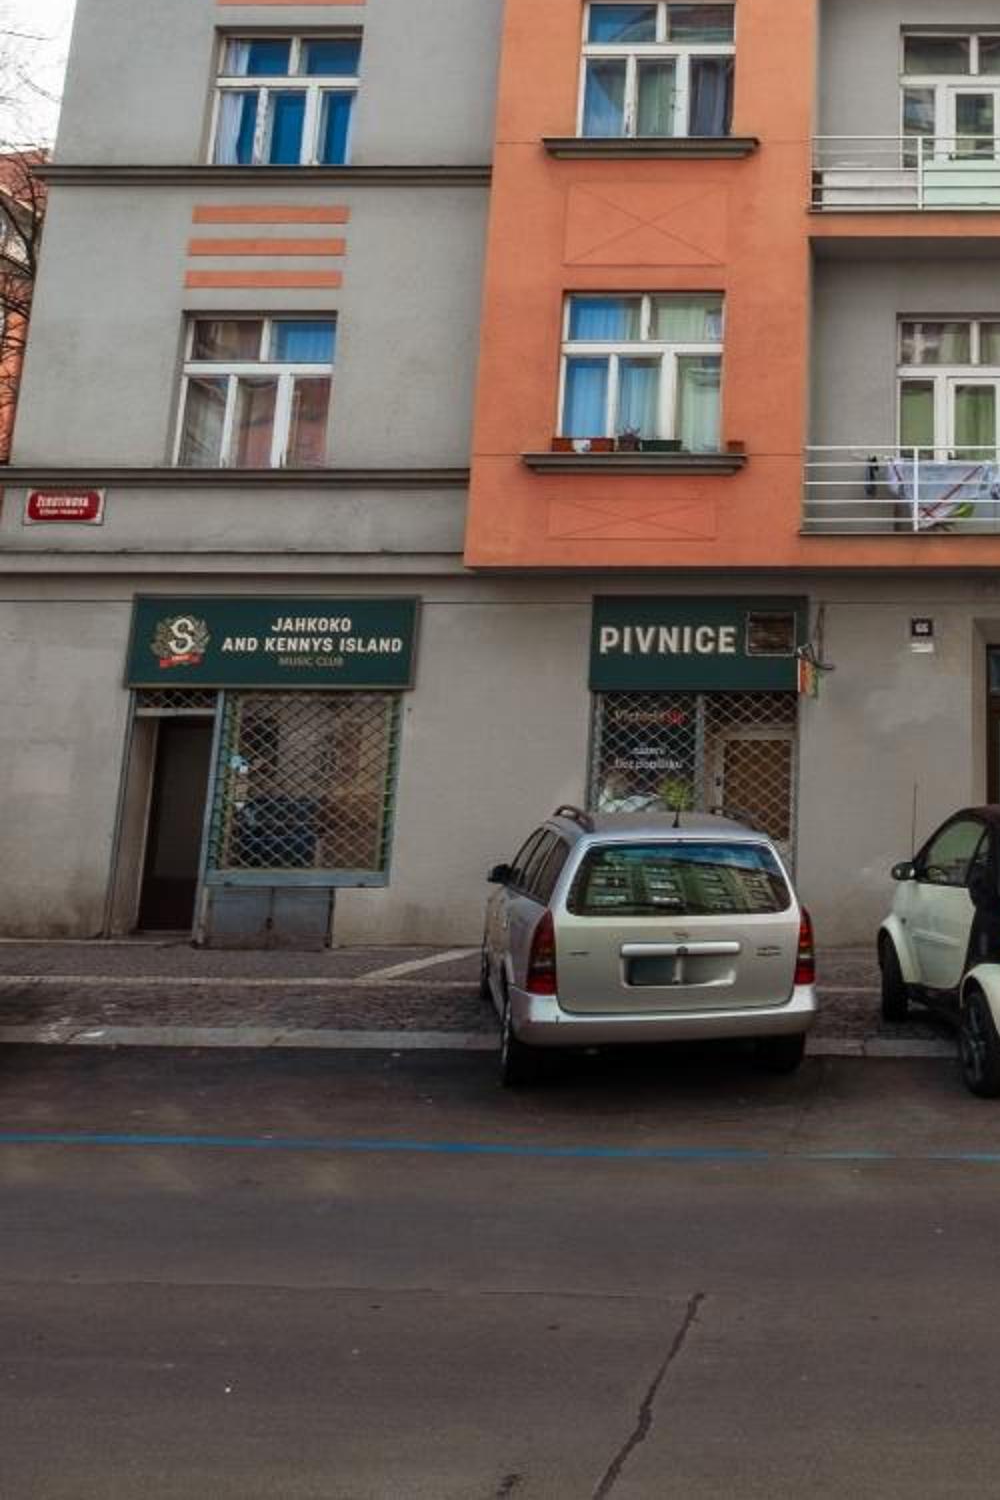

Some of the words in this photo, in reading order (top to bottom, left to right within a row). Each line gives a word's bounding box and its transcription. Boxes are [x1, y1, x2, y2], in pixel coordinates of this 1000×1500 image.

[271, 617, 352, 632] JAHKOKO
[221, 637, 259, 652] AND
[264, 637, 333, 652] KENNYS
[339, 637, 403, 653] ISLAND
[600, 626, 737, 654] PIVNICE
[278, 656, 313, 667] MUSIC
[315, 656, 344, 668] CLUB
